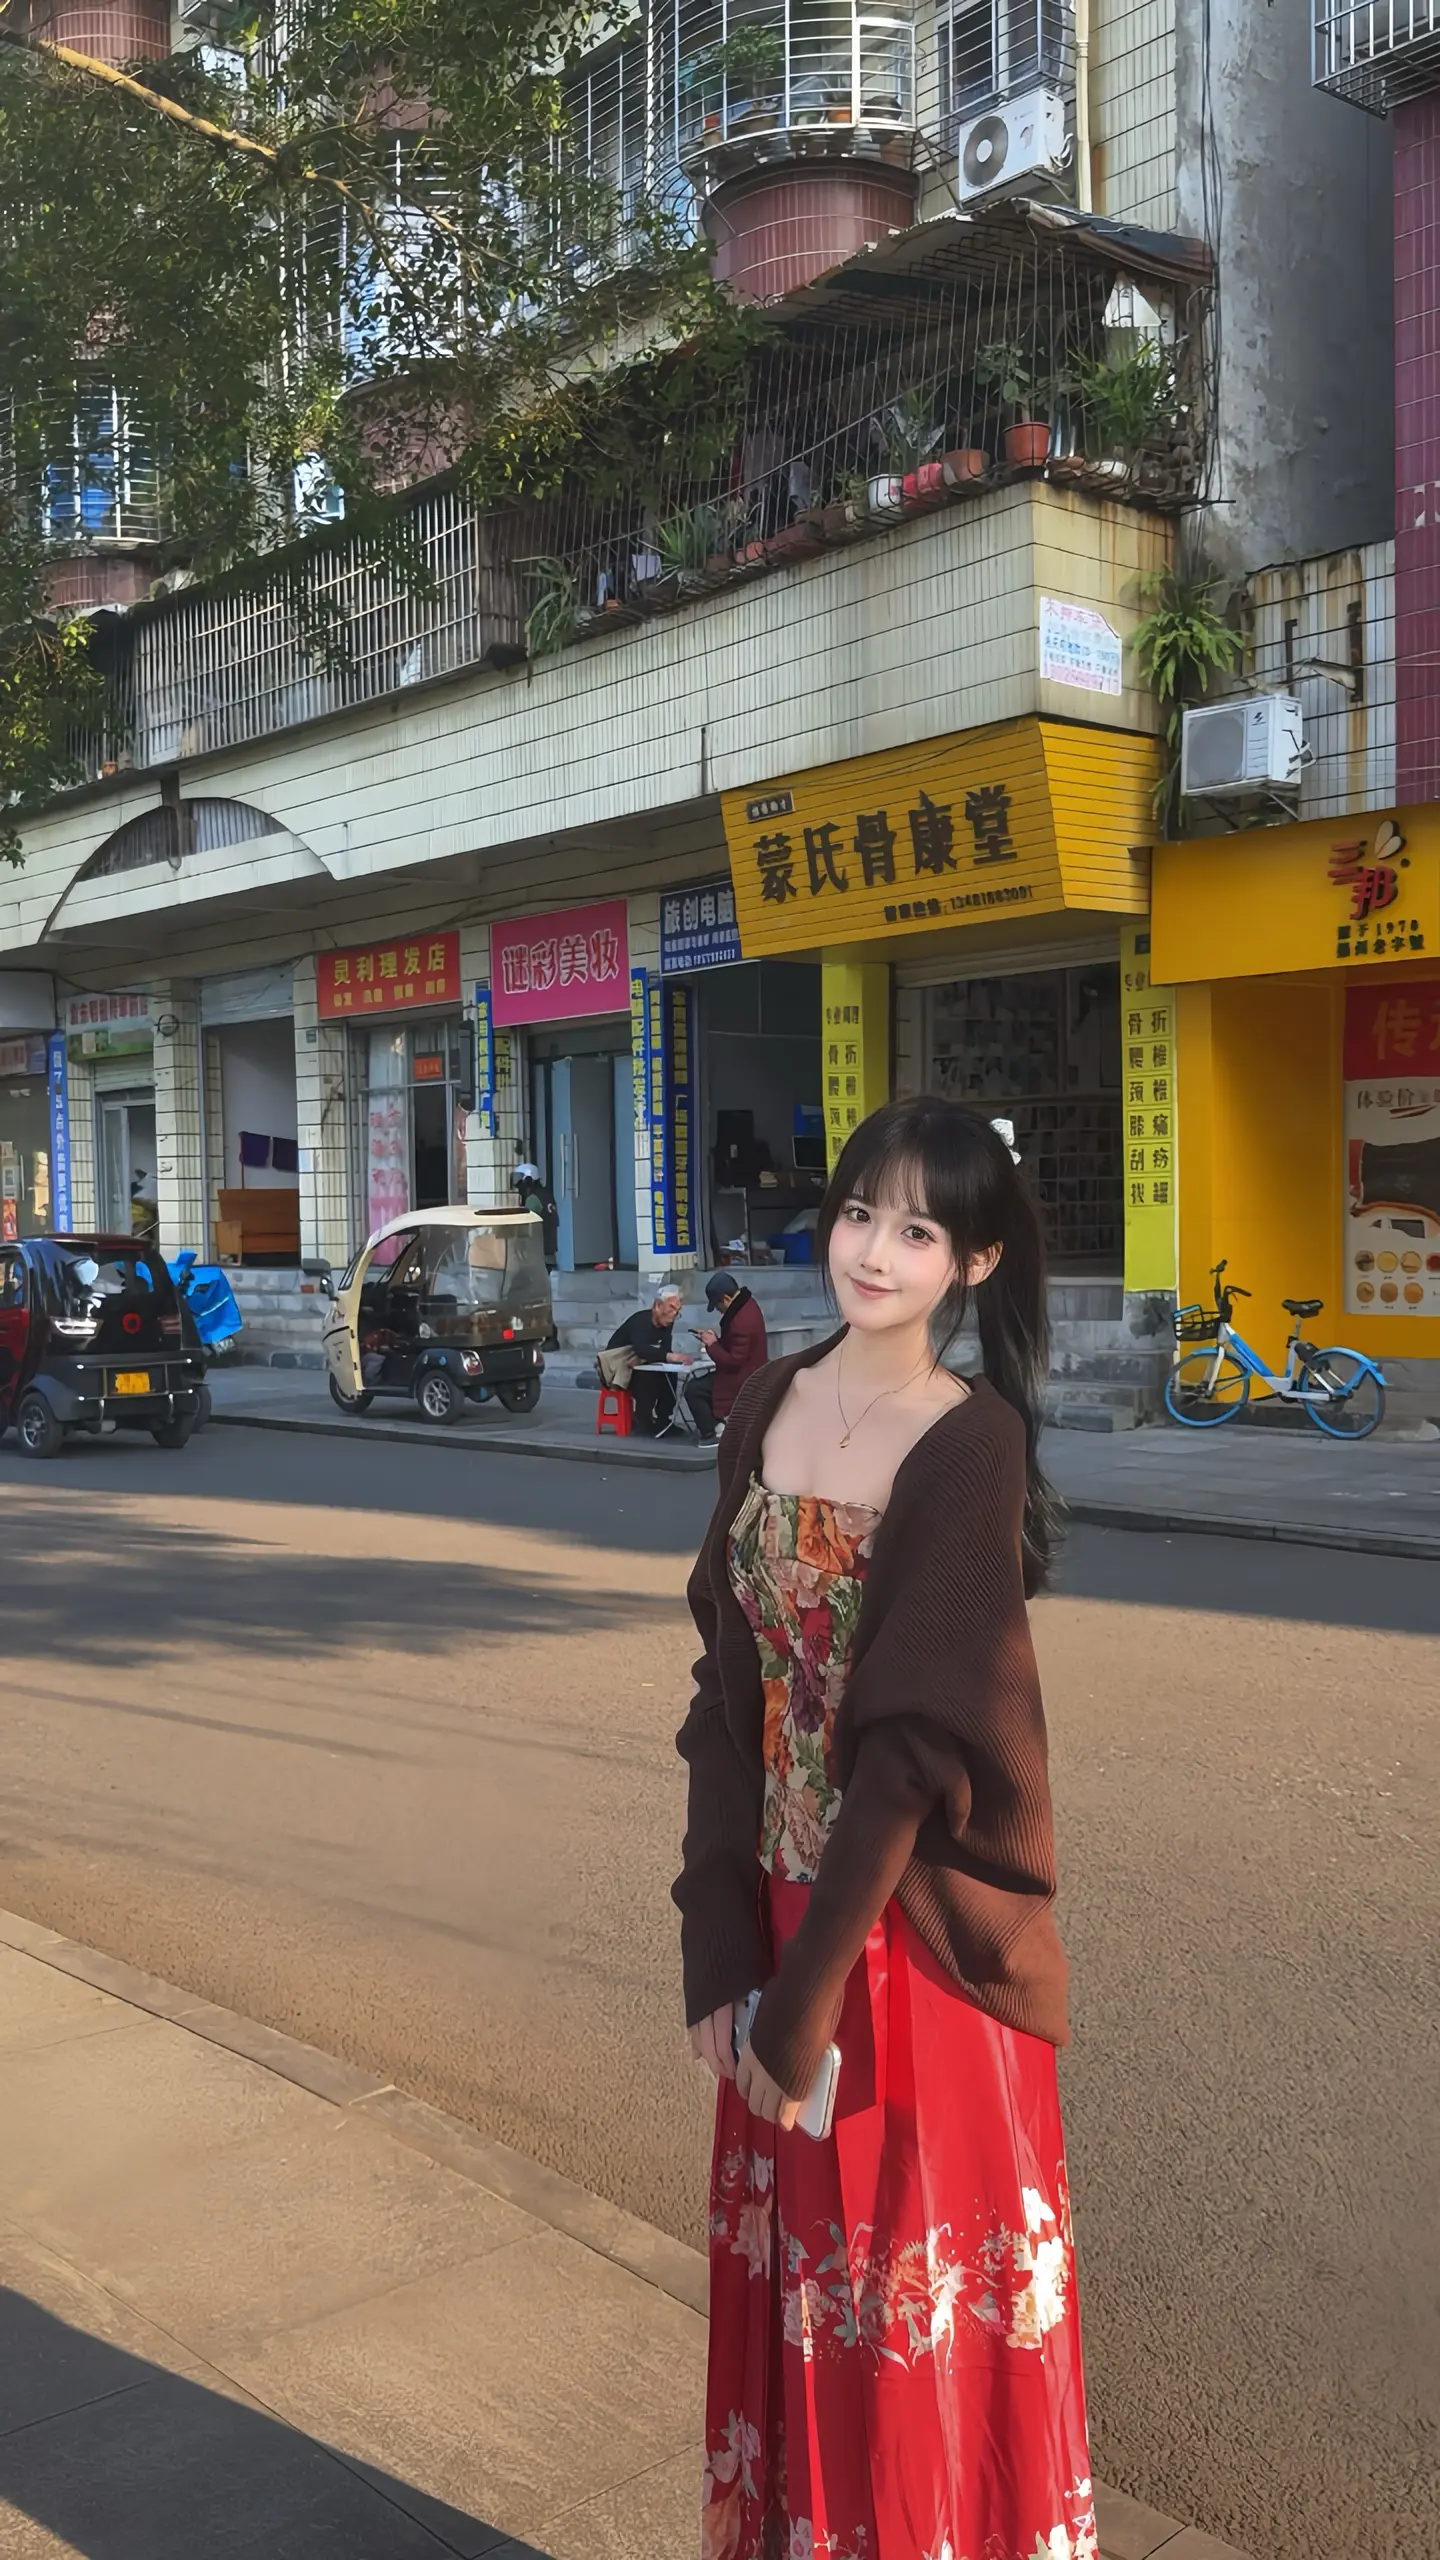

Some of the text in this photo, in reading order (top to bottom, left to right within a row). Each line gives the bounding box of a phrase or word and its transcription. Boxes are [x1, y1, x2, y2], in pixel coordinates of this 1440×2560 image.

[753, 784, 1018, 904] 蒙氏骨康堂
[333, 943, 446, 986] 灵利理发店
[1128, 1010, 1167, 1036] 骨折
[828, 1044, 857, 1065] 骨折
